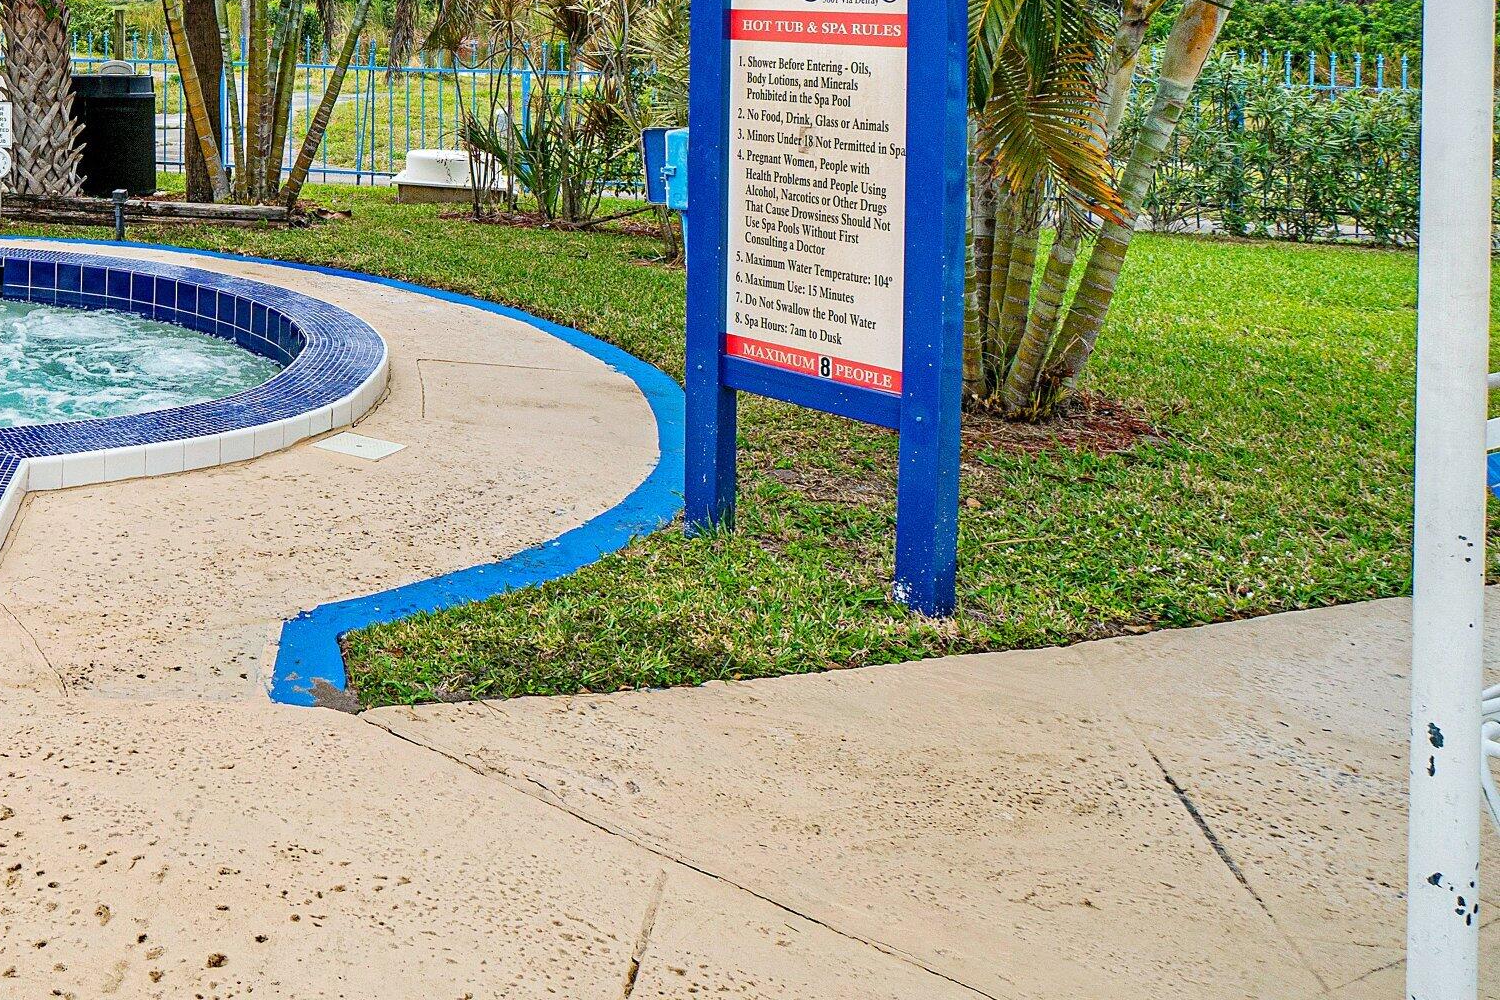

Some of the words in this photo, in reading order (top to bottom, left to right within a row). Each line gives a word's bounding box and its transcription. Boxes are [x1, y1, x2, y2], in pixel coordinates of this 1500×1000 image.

[743, 20, 772, 31] HOT
[775, 21, 803, 32] TUB
[807, 23, 817, 33] &
[822, 23, 847, 34] SPA
[852, 24, 901, 37] RULES
[739, 56, 745, 67] 1.
[748, 56, 776, 69] Shower
[779, 58, 804, 70] Before
[807, 60, 842, 75] Entering
[851, 62, 872, 77] Oils,
[747, 72, 766, 87] Body
[769, 74, 801, 89] Lotions,
[804, 77, 818, 87] and
[821, 77, 858, 91] Minerals
[747, 88, 787, 102] Prohibited
[790, 92, 797, 102] in
[800, 93, 812, 104] the
[814, 93, 829, 108] Spa
[832, 95, 850, 107] Pool
[738, 108, 744, 119] 2.
[747, 109, 758, 120] No
[761, 110, 783, 124] Food,
[786, 112, 812, 127] Drink,
[815, 115, 838, 128] Glass
[841, 120, 850, 128] or
[852, 118, 889, 132] Animals
[738, 129, 744, 140] 3.
[747, 129, 774, 143] Minors
[777, 132, 802, 146] Under
[804, 134, 813, 147] 18
[815, 136, 831, 149] Not
[834, 138, 875, 153] Permitted
[878, 144, 887, 154] in
[890, 143, 906, 158] Spa
[737, 149, 744, 160] 4.
[747, 150, 781, 165] Pregnant
[784, 154, 817, 170] Women,
[820, 158, 848, 174] People
[850, 162, 870, 174] with
[746, 168, 771, 182] Health
[774, 171, 810, 186] Problems
[813, 178, 828, 189] and
[830, 179, 858, 194] People
[861, 182, 886, 199] Using
[746, 185, 778, 200] Alcohol,
[781, 189, 819, 204] Narcotics
[822, 197, 830, 206] or
[833, 196, 858, 210] Other
[860, 199, 887, 216] Drugs
[745, 216, 759, 228] Use
[762, 218, 776, 233] Spa
[778, 221, 799, 234] Pools
[802, 224, 836, 240] Without
[839, 230, 859, 243] First
[746, 200, 763, 213] That
[766, 203, 789, 217] Cause
[792, 207, 839, 224] Drowsiness
[841, 213, 870, 229] Should
[874, 218, 890, 231] Not
[745, 232, 787, 251] Consulting
[796, 240, 825, 255] Doctor
[736, 251, 743, 262] 5.
[746, 252, 785, 269] Maximum
[788, 260, 812, 275] Water
[814, 264, 870, 284] Temperature:
[736, 272, 742, 282] 6.
[745, 272, 784, 291] Maximum
[788, 281, 805, 294] Use:
[808, 285, 817, 297] 15
[820, 287, 854, 303] Minutes
[736, 292, 742, 303] 7.
[745, 293, 756, 306] Do
[759, 296, 774, 309] Not
[776, 300, 810, 316] Swallow
[813, 308, 825, 319] the
[828, 310, 847, 324] Pool
[850, 314, 876, 330] Water
[736, 312, 742, 323] 8.
[745, 314, 758, 328] Spa
[761, 317, 787, 333] Hours:
[790, 324, 806, 337] 7am
[809, 329, 817, 339] to
[820, 330, 842, 345] Dusk
[743, 343, 815, 370] MAXIMUM
[820, 357, 830, 376] 8
[835, 363, 892, 387] PEOPLE
